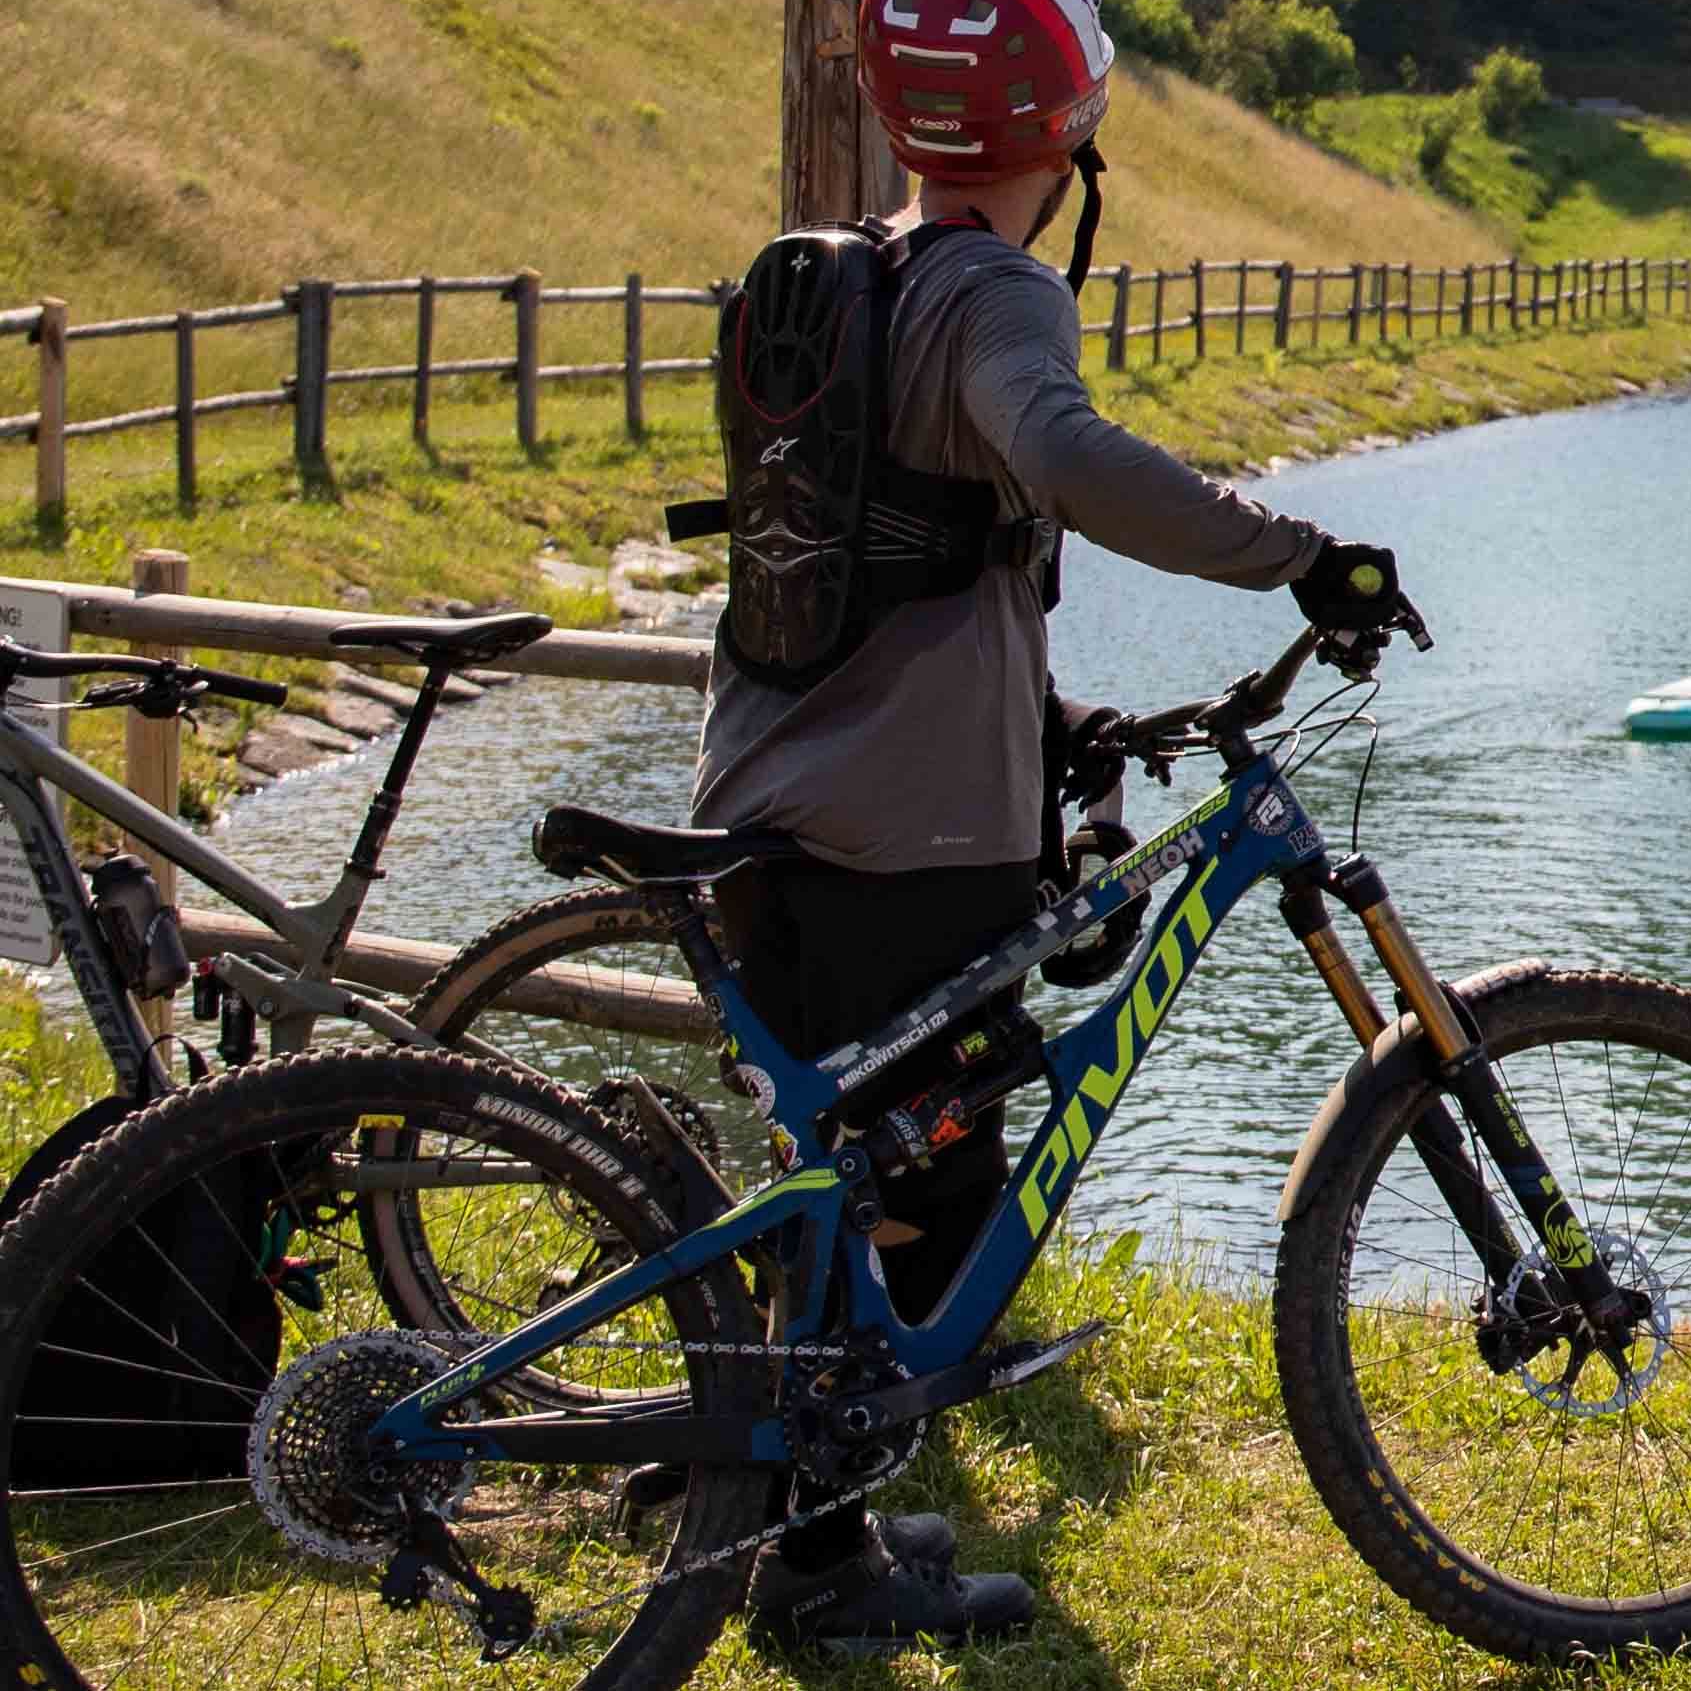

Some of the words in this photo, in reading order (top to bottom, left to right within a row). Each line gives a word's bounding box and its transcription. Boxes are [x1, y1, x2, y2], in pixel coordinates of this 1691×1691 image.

[1119, 826, 1206, 896] NEOH
[836, 1023, 930, 1093] MIKOWITSCH
[1018, 854, 1219, 1240] PIVOT
[472, 1093, 570, 1141] MINION
